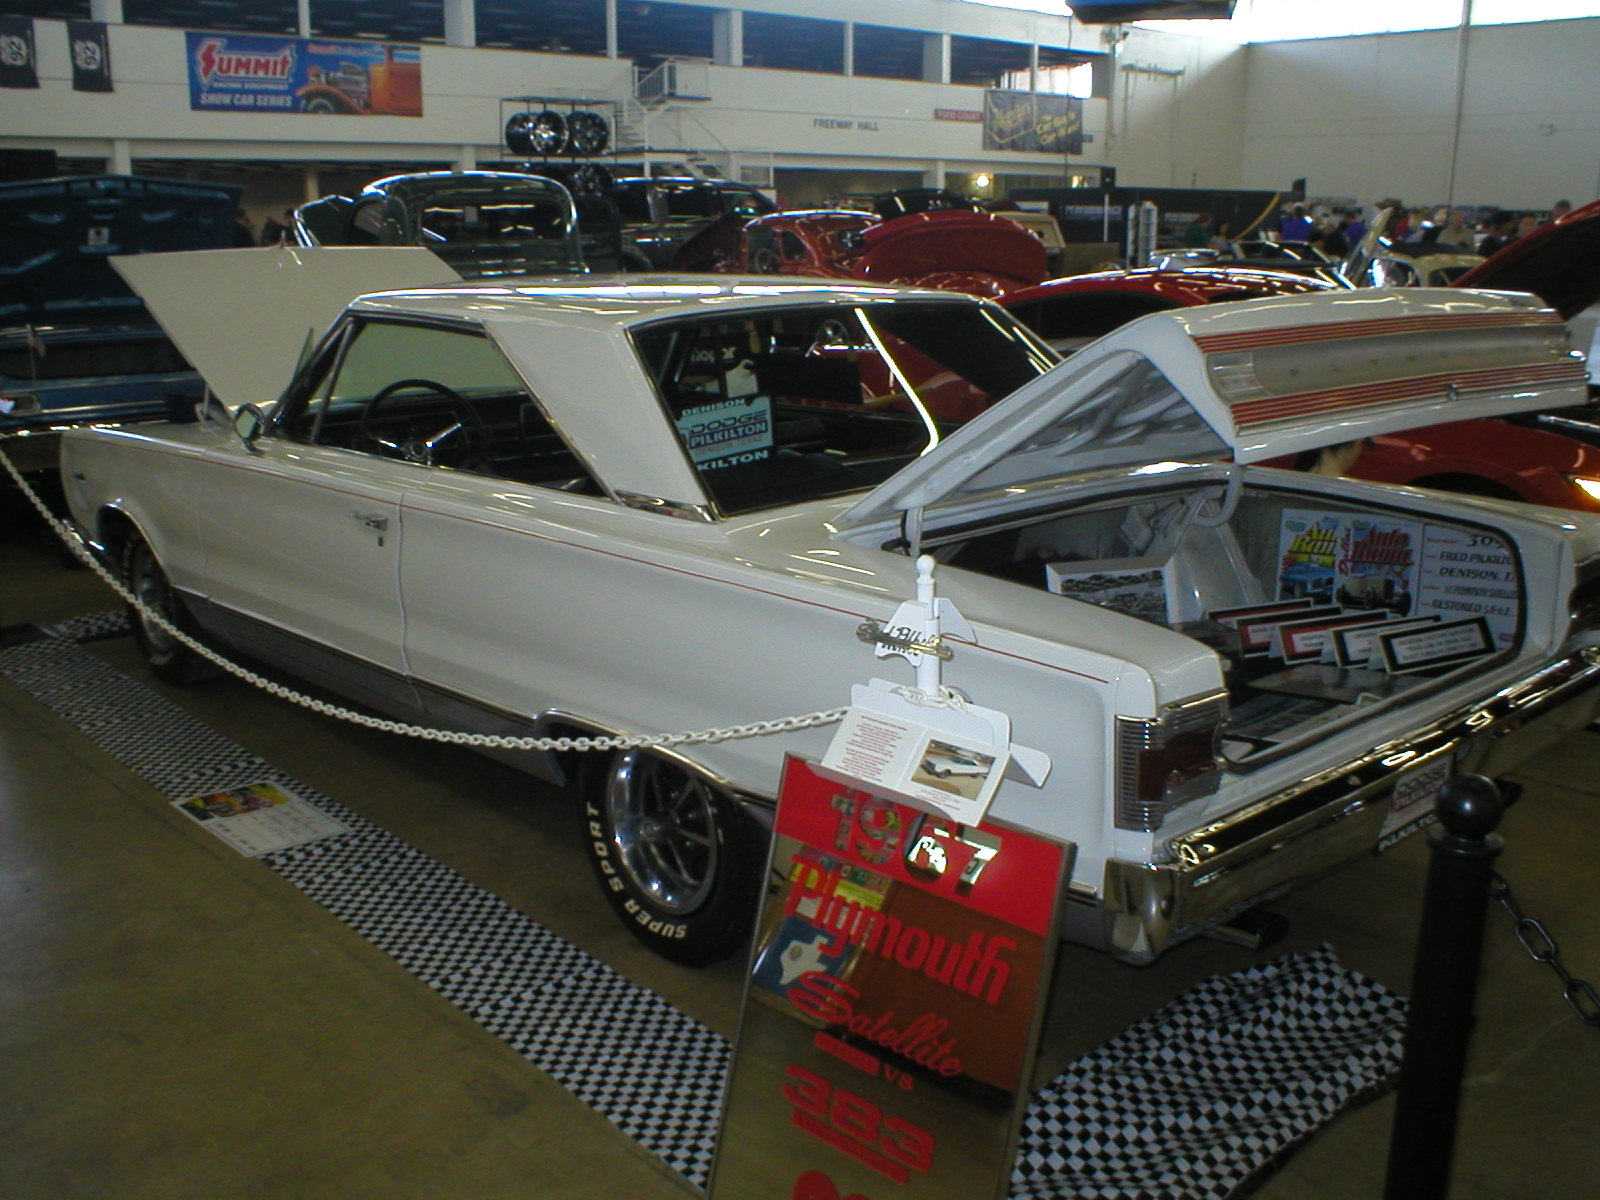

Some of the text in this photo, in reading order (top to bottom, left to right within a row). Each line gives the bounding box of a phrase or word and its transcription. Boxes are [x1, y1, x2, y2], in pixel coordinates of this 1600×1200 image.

[201, 93, 293, 107] SHOW CAR SERIES
[813, 118, 880, 131] FREEWAY HALL
[682, 399, 745, 416] DENISON
[690, 410, 767, 435] DODGE
[691, 421, 766, 448] PILKILTON
[697, 450, 769, 471] KILTON
[1440, 551, 1468, 562] FRED
[1431, 599, 1482, 612] RESTORED
[831, 787, 1002, 898] 1967
[586, 801, 687, 939] SUPER SPORT
[783, 854, 1018, 1004] Plymouth
[786, 971, 963, 1076] Satellite
[783, 1064, 934, 1172] 383
